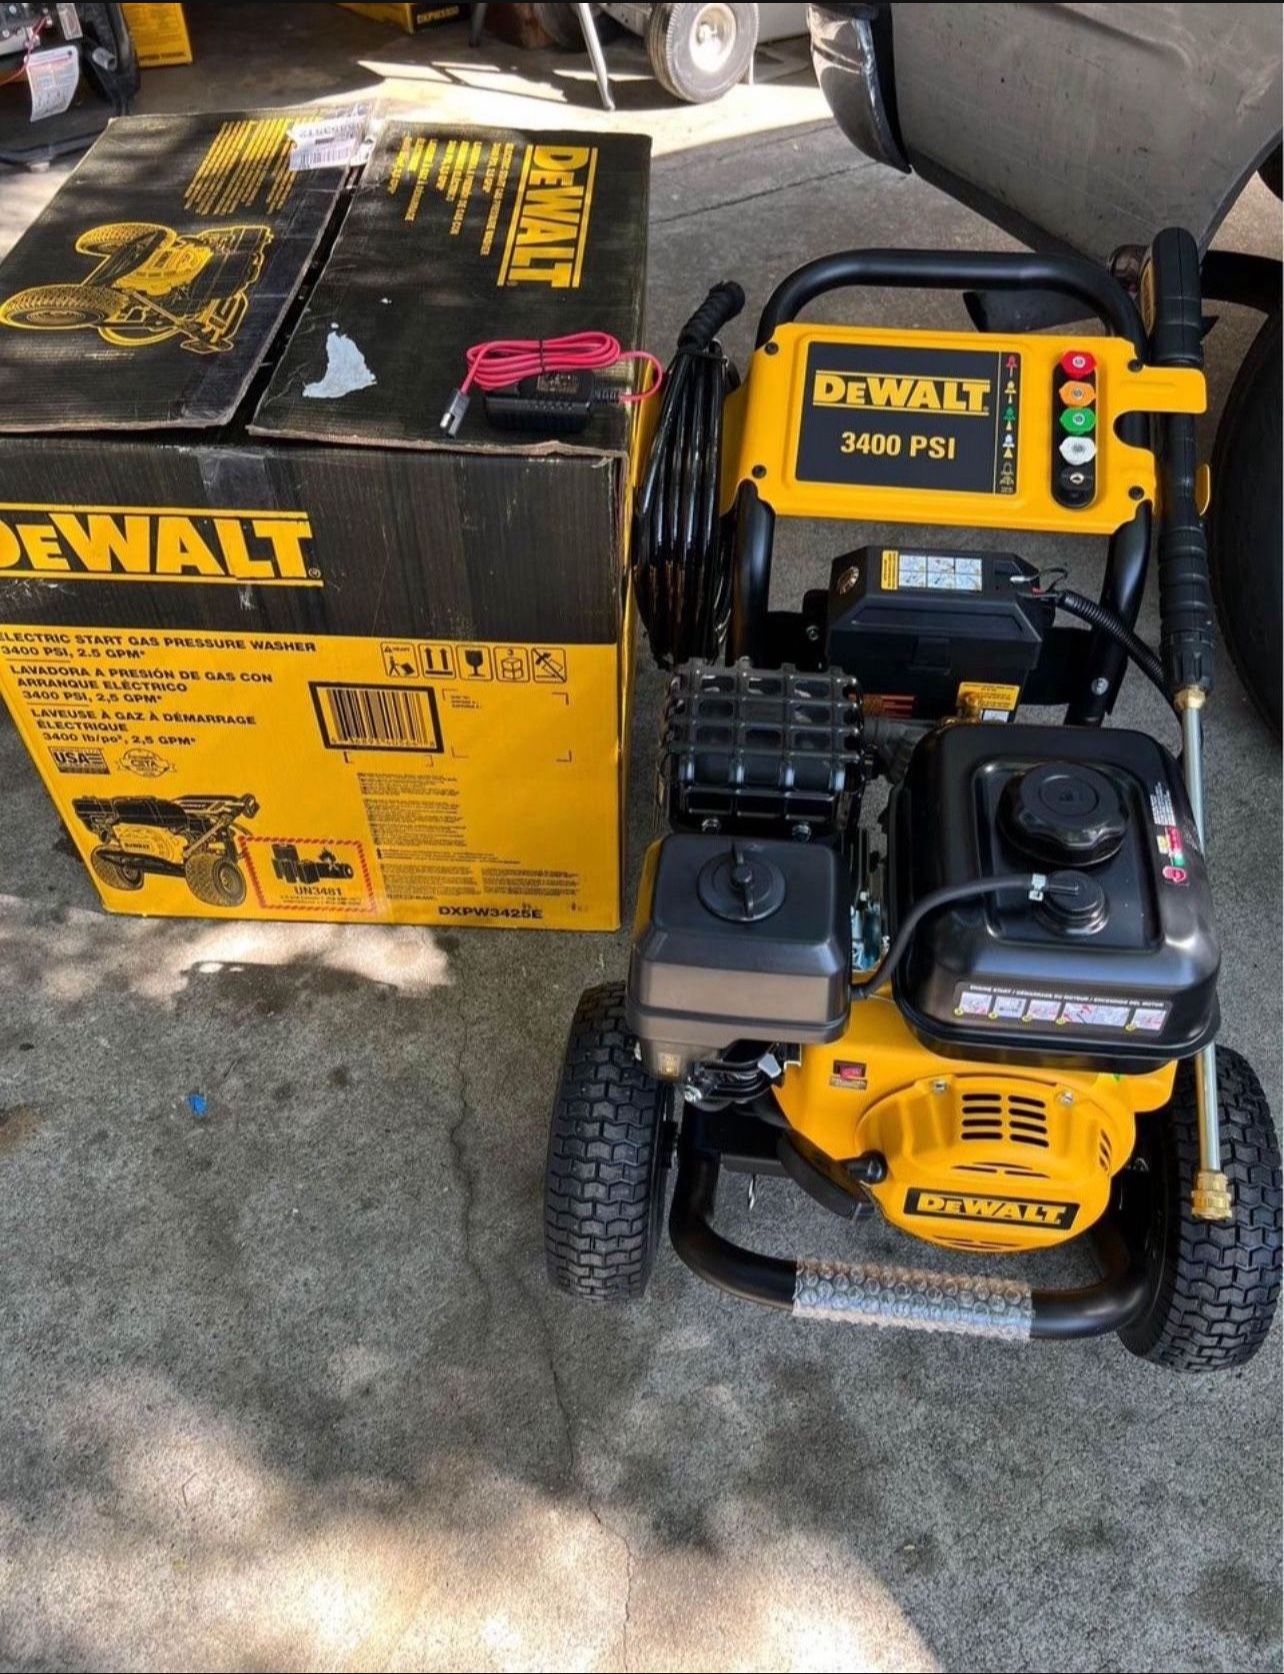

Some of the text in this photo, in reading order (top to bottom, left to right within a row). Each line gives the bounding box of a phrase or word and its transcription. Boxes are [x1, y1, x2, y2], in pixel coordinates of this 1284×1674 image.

[841, 431, 956, 460] 3400 PSI
[75, 635, 122, 646] START
[128, 636, 159, 647] GAS
[165, 637, 245, 650] PRESSURE
[251, 640, 316, 653] WASHER
[2, 646, 39, 656] 3400
[44, 647, 73, 658] PSI,
[77, 648, 101, 658] 2.5
[10, 665, 273, 683] LAVADORA A PRESIÓN DE GAS CON
[18, 679, 188, 693] ARRANQUE ELÉCTRICO
[23, 691, 60, 701] 3400
[64, 692, 92, 703] PSI,
[96, 693, 119, 704] 2,5
[31, 708, 256, 725] LAVEUSE À GAZ À DÉMARRAGE
[37, 719, 128, 733] ÉLECTRIQUE
[43, 732, 79, 742] 3400
[132, 734, 154, 745] 2,5
[54, 751, 89, 764] USA
[439, 906, 543, 919] DXPW3425E
